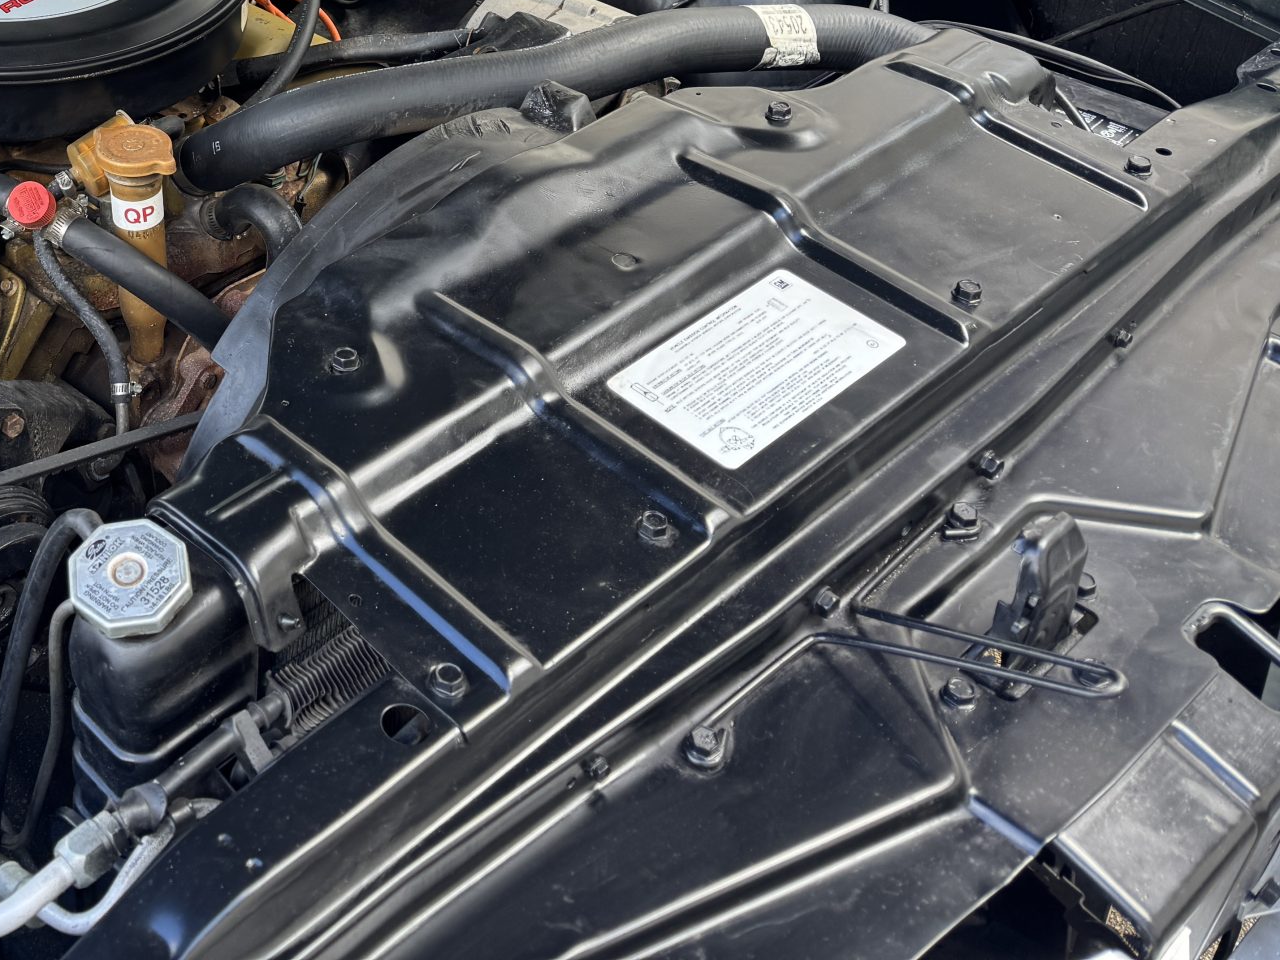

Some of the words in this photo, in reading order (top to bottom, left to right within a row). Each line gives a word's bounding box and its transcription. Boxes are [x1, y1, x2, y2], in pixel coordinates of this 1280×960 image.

[124, 205, 155, 224] QP
[119, 585, 146, 612] CAUTION
[142, 556, 173, 588] PRESSURE
[139, 574, 170, 606] 31528
[83, 590, 111, 613] WARNING
